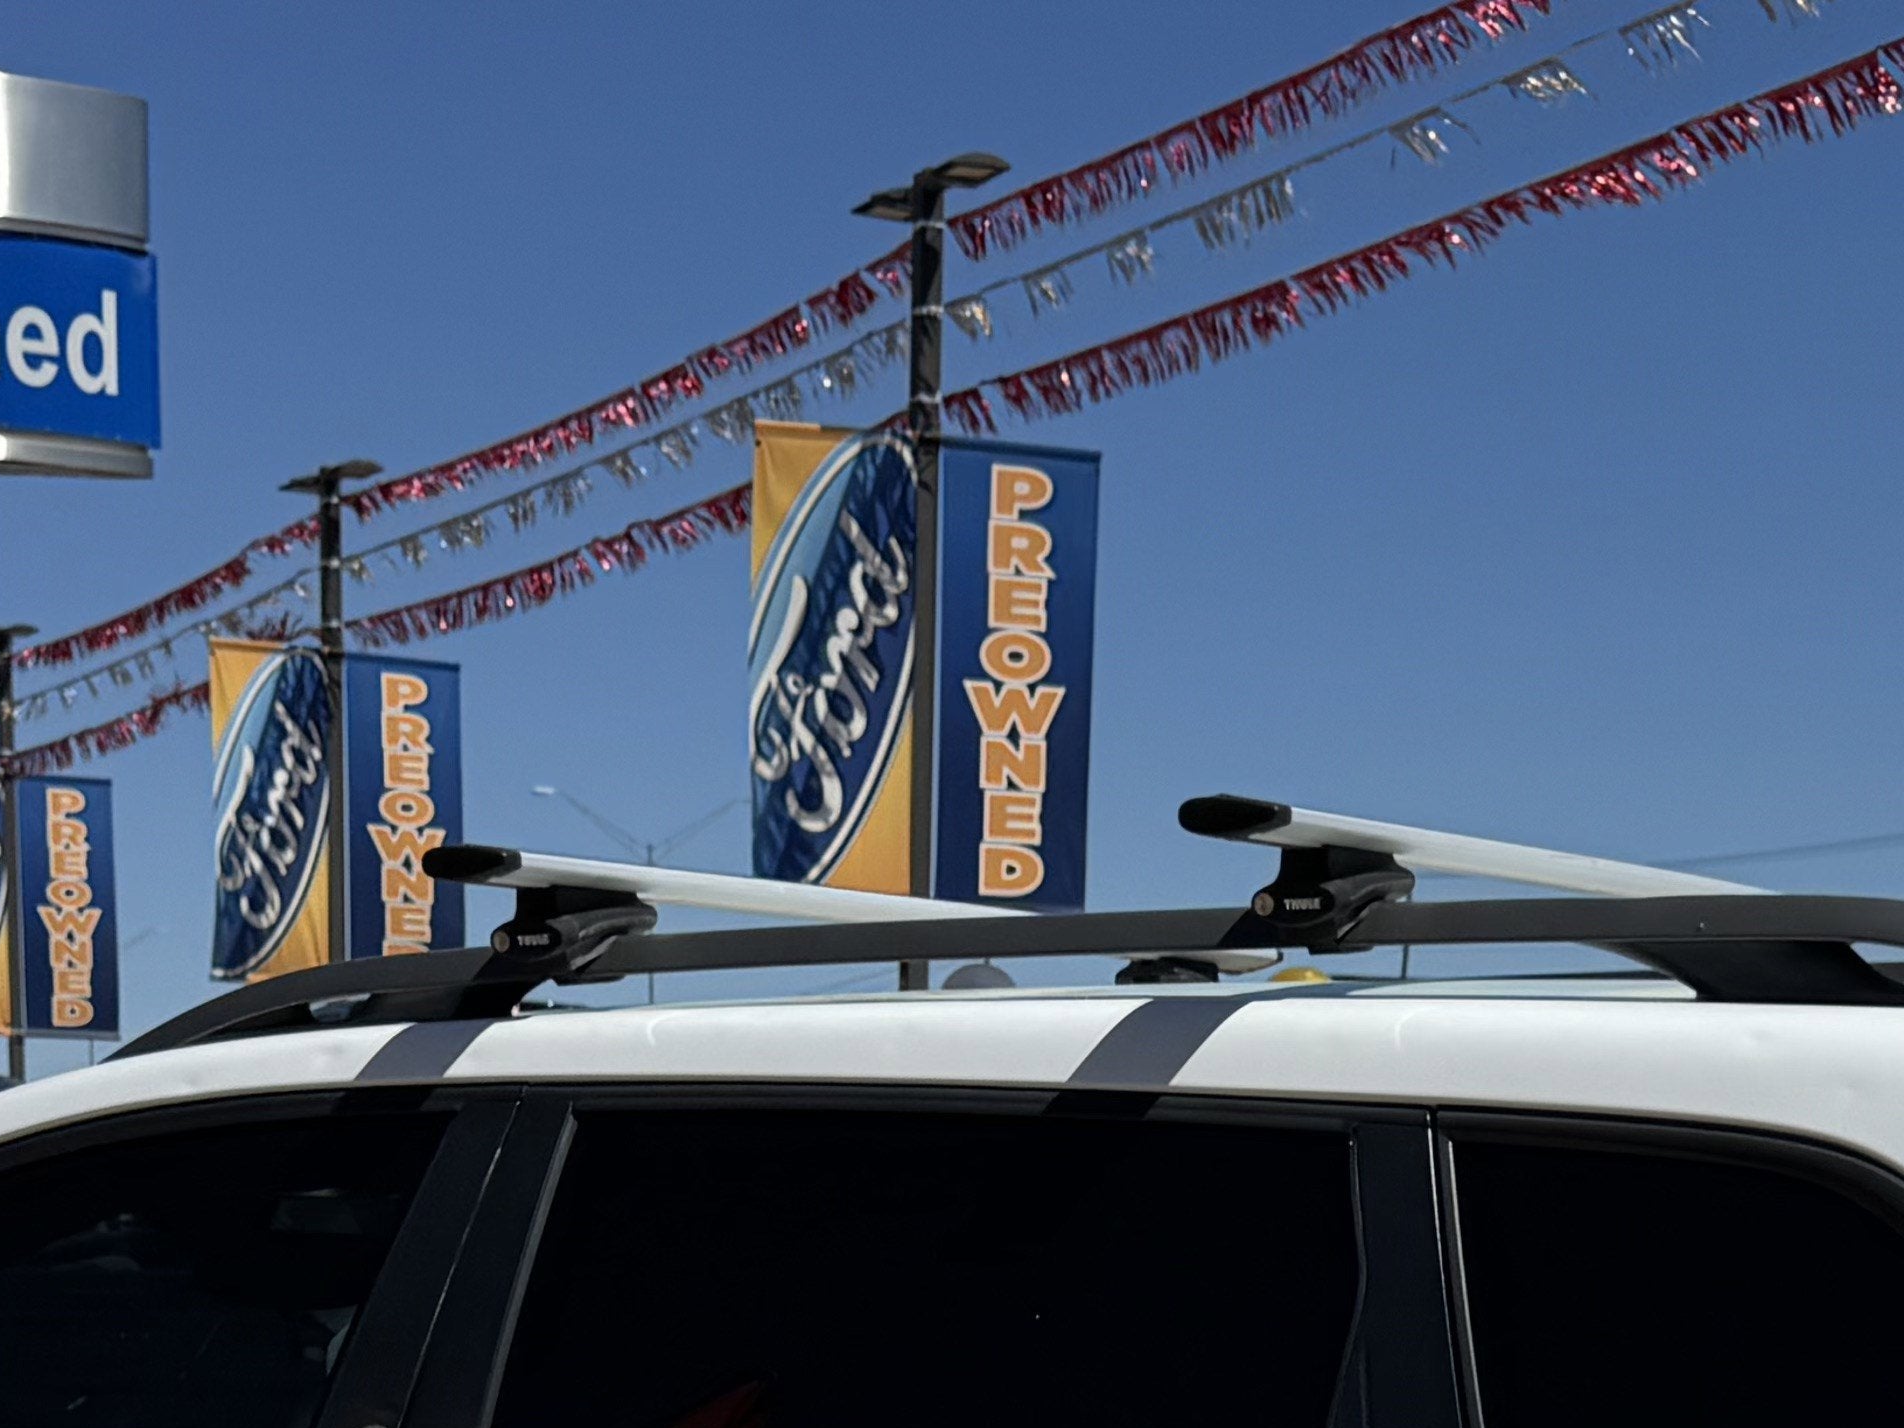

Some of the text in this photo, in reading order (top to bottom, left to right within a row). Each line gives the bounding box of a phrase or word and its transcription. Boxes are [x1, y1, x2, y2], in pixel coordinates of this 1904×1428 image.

[751, 508, 909, 833] Ford
[963, 463, 1066, 897] PREOWNED
[37, 786, 102, 1028] PREOWNED
[214, 699, 323, 930] Ford
[366, 672, 446, 957] PREOWNE
